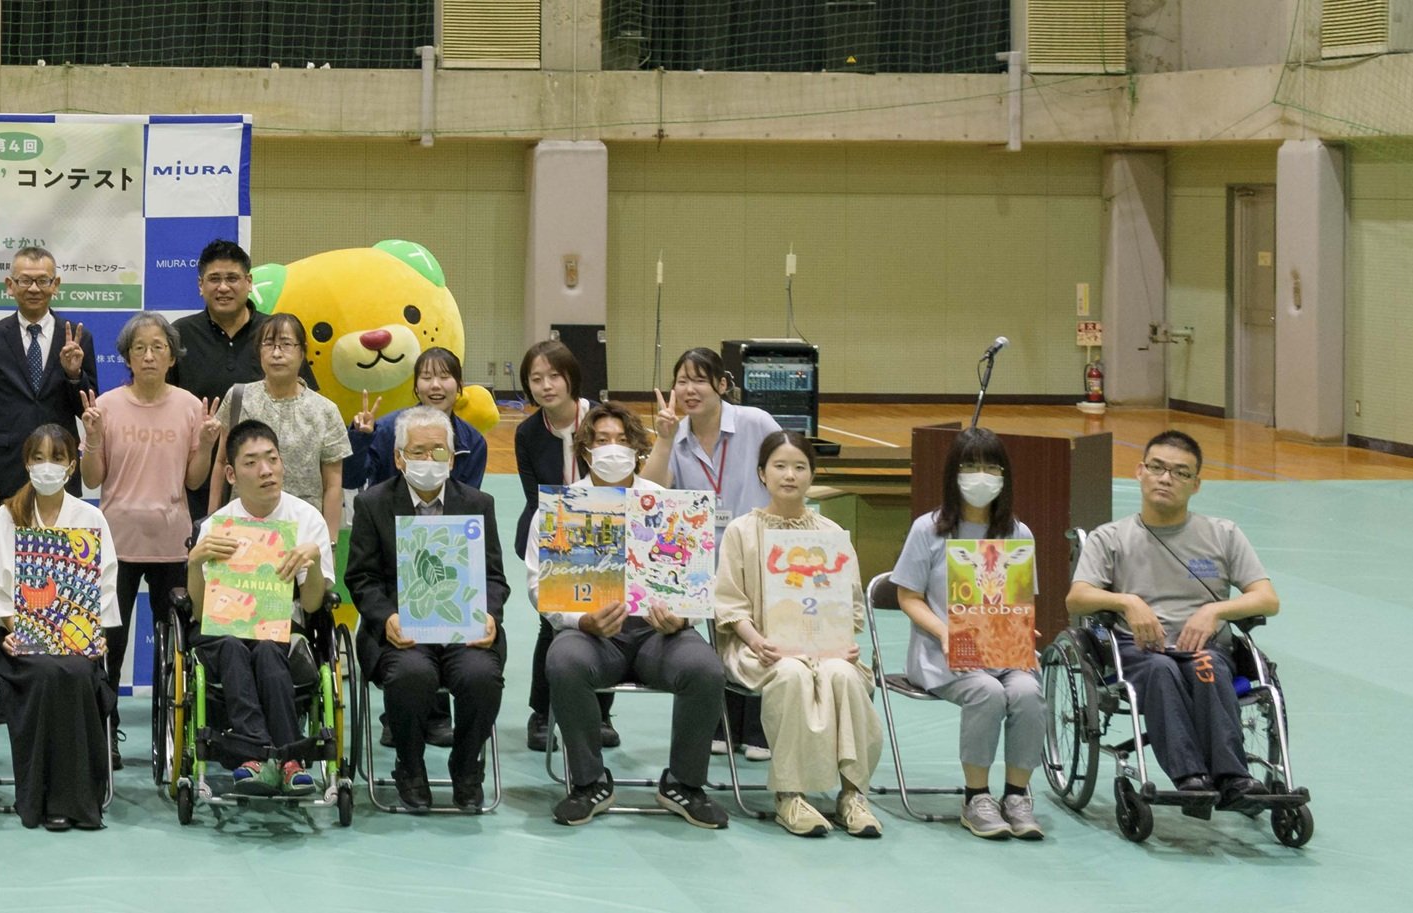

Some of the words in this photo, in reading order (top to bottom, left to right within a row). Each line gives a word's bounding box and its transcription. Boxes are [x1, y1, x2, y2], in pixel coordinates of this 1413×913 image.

[156, 259, 186, 268] MIURA
[122, 424, 177, 447] Hope
[464, 518, 481, 540] 6
[235, 579, 288, 593] JANUARY
[573, 583, 593, 603] 12
[951, 581, 973, 601] 10
[801, 597, 818, 615] 2
[950, 603, 1032, 615] October
